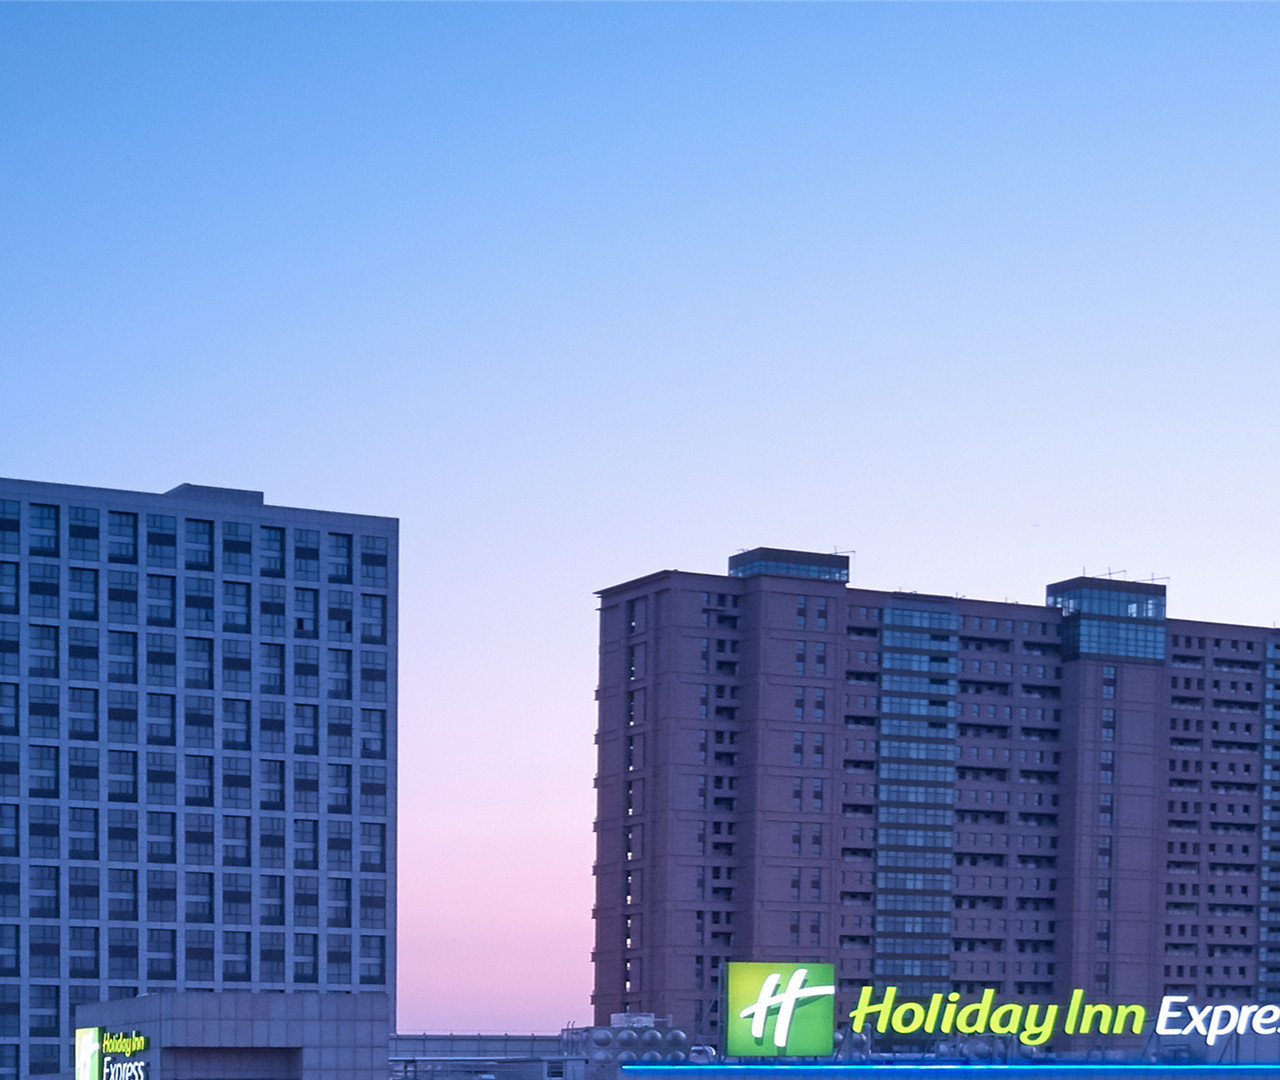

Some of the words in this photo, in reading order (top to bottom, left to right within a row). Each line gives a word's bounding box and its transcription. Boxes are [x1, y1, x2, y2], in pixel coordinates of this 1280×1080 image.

[849, 986, 1059, 1046] Holiday
[1065, 988, 1146, 1035] Inn
[102, 1032, 131, 1057] Holiday
